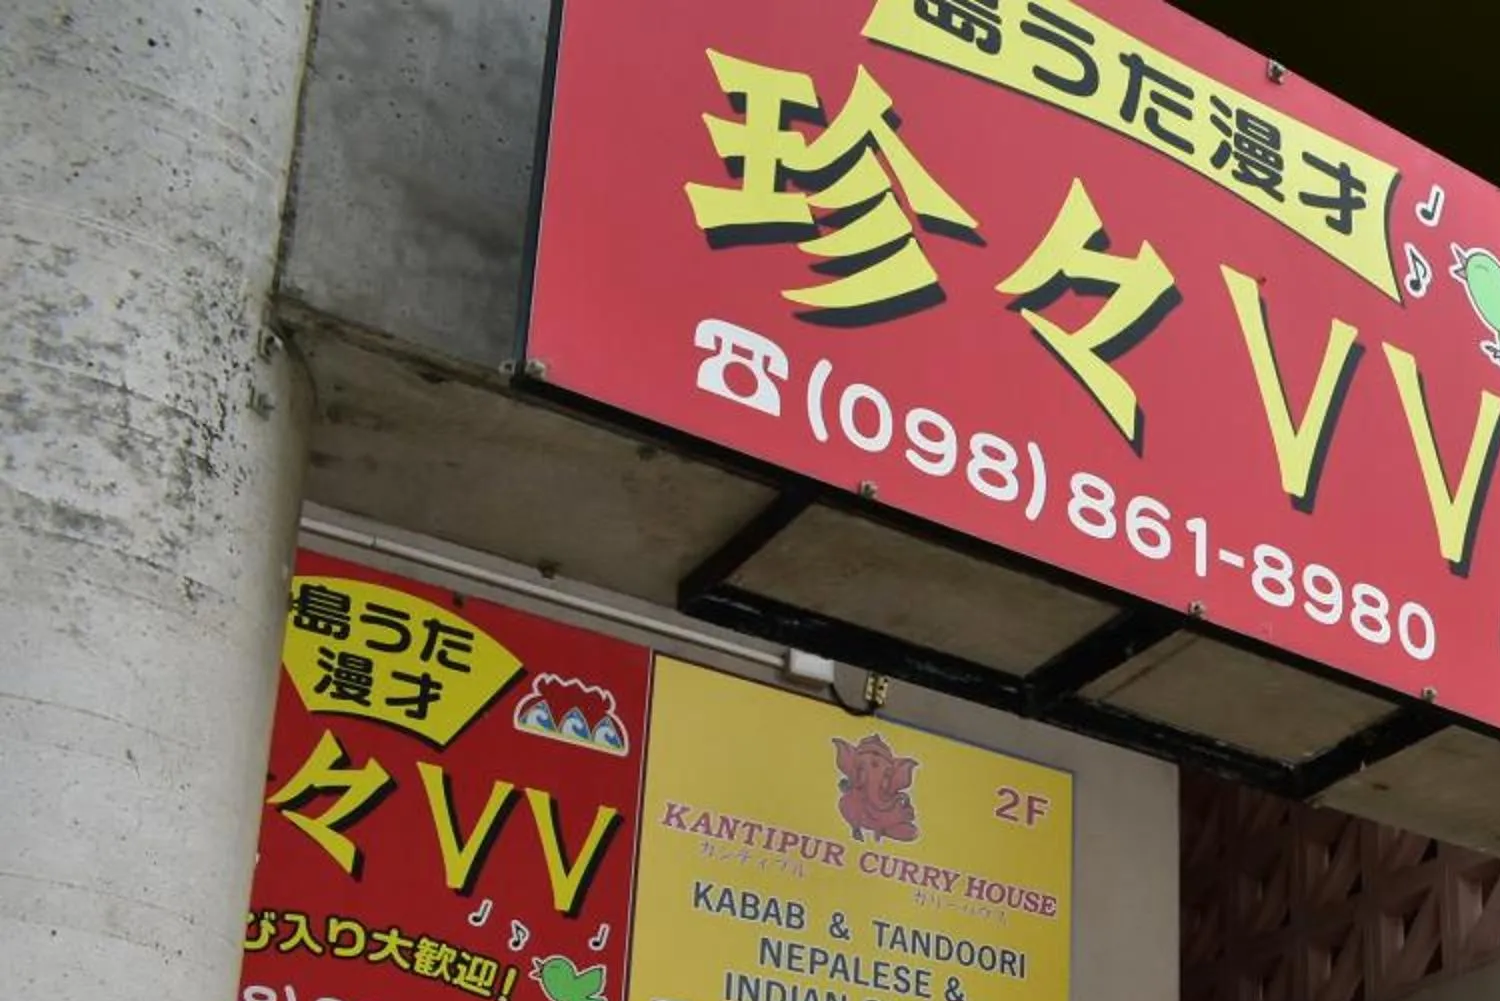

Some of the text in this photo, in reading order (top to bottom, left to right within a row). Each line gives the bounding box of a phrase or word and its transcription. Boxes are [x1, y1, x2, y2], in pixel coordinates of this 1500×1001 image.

[806, 357, 1436, 661] (098)861-8980
[289, 583, 475, 674] 島うた
[313, 646, 443, 720] 漫才
[994, 786, 1049, 827] 2F
[662, 801, 1059, 918] KANTIPUR CURRY HOUSE
[691, 881, 1027, 980] KABAB & TANDOORI
[758, 936, 932, 1000] NEPALESE
